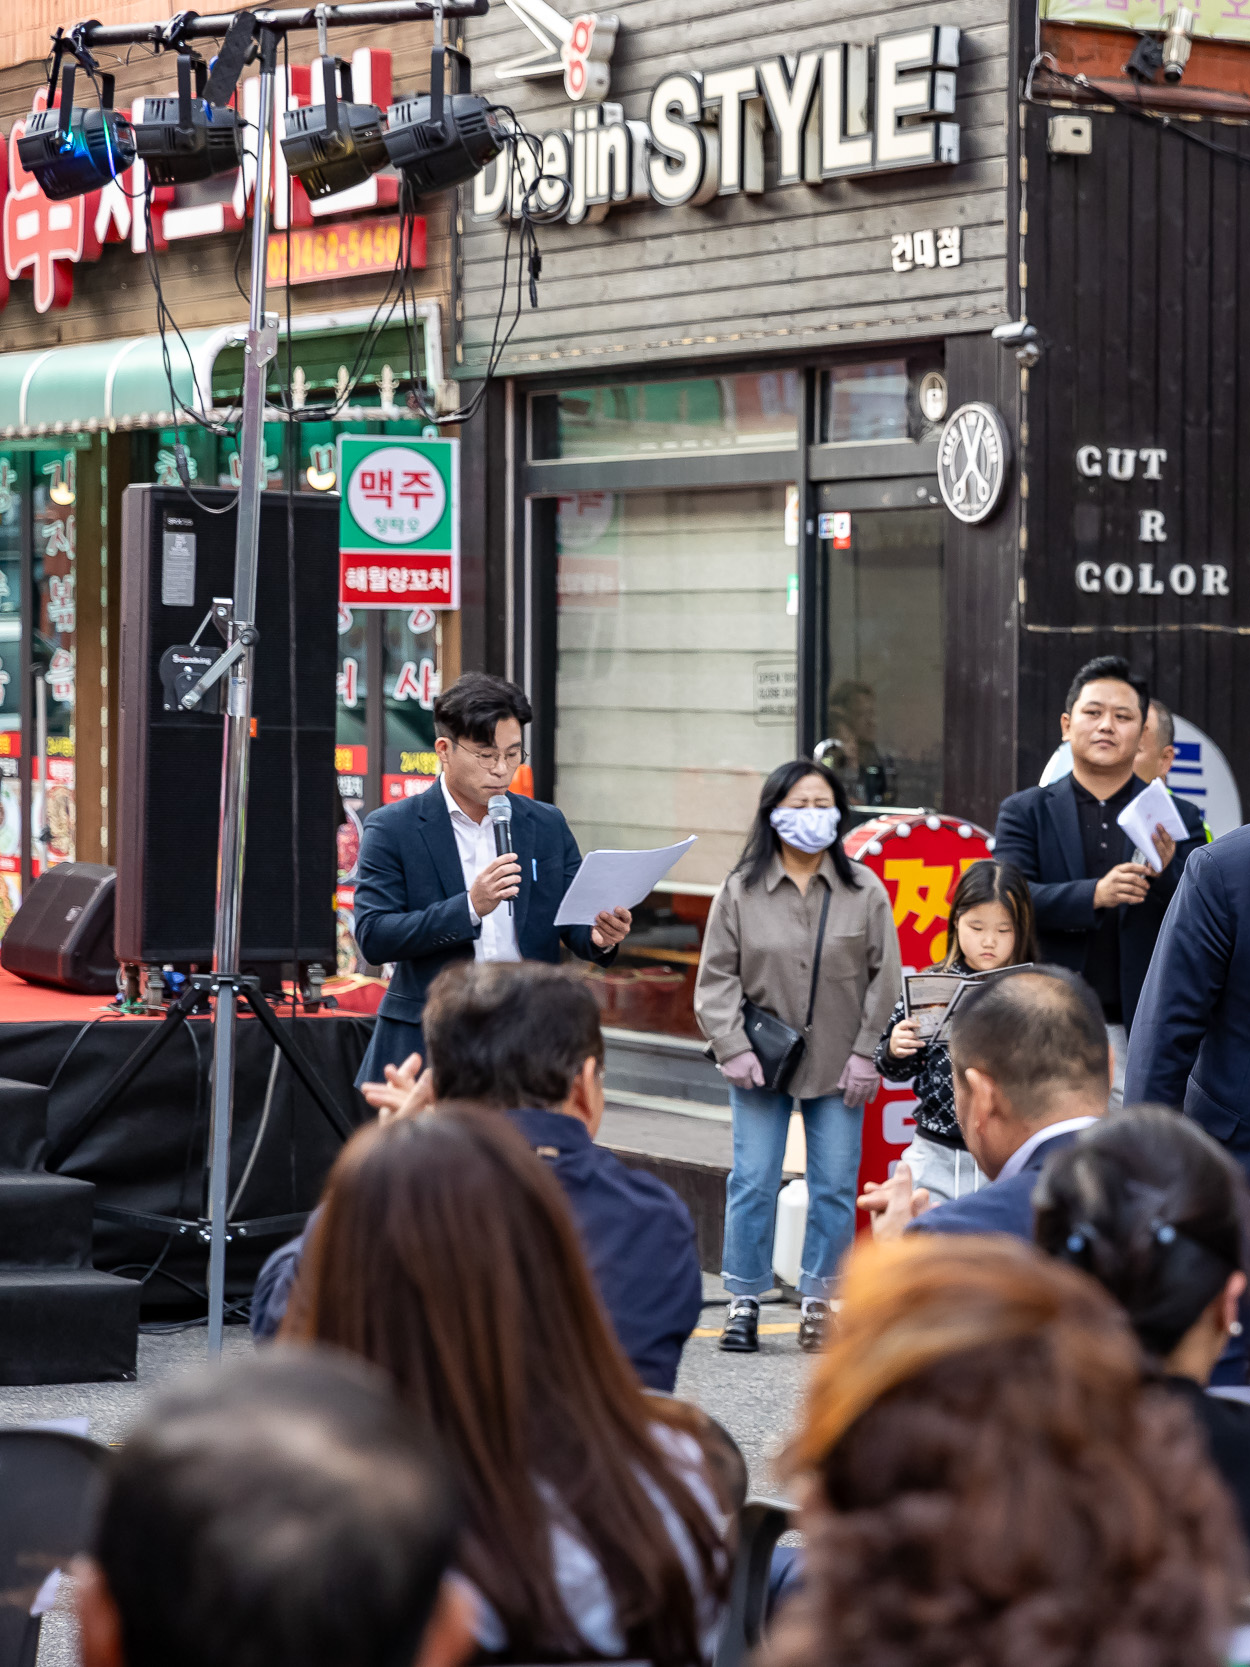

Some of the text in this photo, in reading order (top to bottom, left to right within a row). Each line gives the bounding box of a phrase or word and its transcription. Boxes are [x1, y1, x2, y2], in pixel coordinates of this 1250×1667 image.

[472, 107, 628, 223] Daejin
[650, 26, 938, 207] STYLE
[1076, 445, 1167, 481] CUT
[361, 470, 434, 510] 맥주
[1139, 510, 1167, 542] R
[1076, 561, 1229, 596] COLOR
